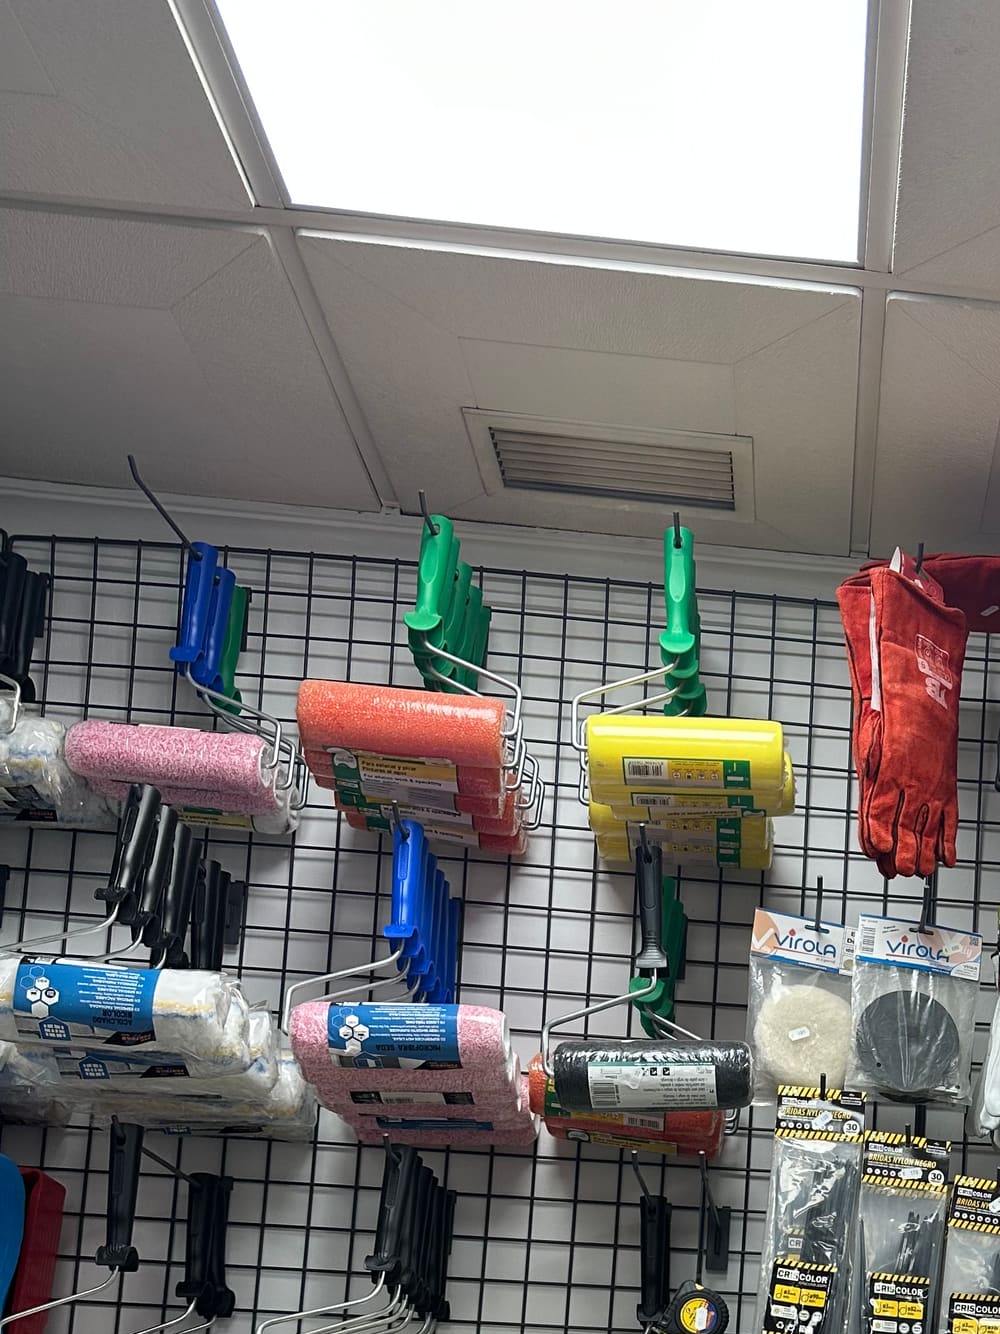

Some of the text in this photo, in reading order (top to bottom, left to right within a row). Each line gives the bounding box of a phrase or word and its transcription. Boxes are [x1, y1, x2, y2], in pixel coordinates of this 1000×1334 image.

[869, 1153, 936, 1168] BRIDAS NYLON NEGRO
[956, 1198, 979, 1207] BRIDAS
